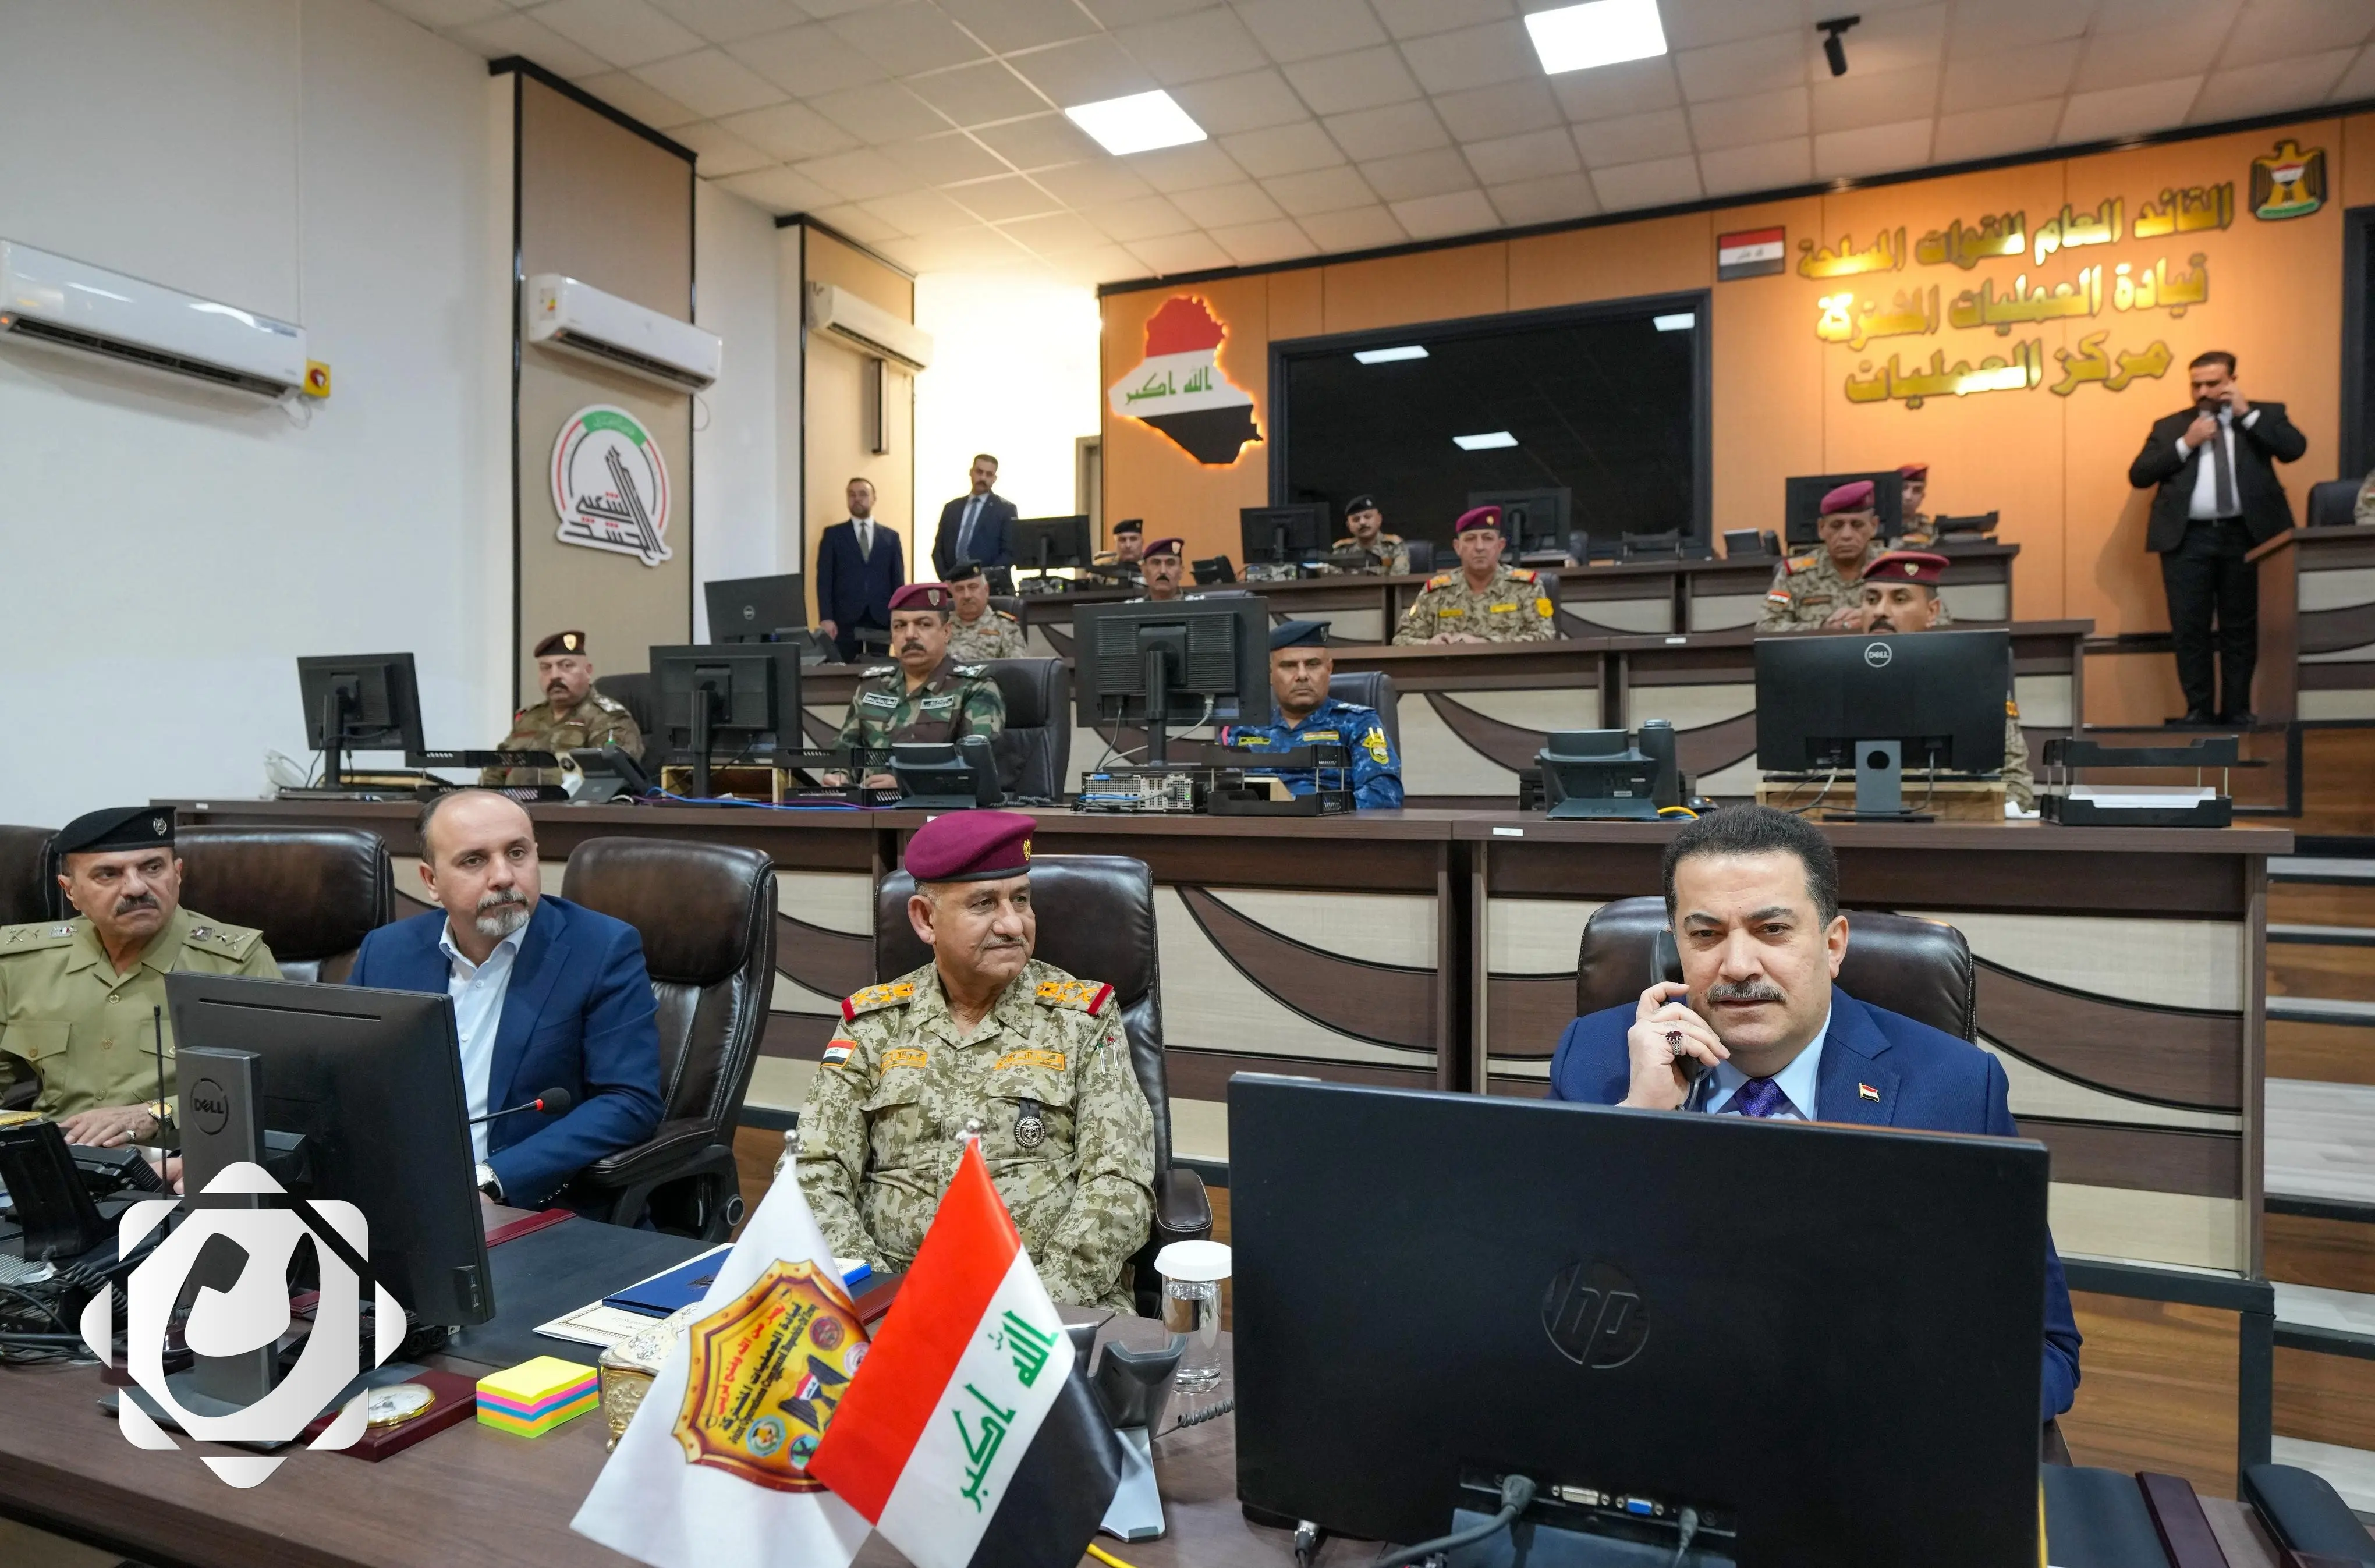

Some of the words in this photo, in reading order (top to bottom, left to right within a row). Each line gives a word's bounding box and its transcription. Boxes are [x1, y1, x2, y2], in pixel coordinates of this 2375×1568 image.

[2034, 196, 2124, 266] العام
[2133, 181, 2234, 238] القائد
[1797, 226, 1907, 281] المسلحة
[1916, 210, 2026, 270] للقوات
[1948, 263, 2103, 336] العمليات
[2114, 253, 2208, 318] قيادة
[1816, 283, 1940, 350] المشتركة
[1183, 366, 1213, 393] الله
[1845, 337, 2043, 410] العمليات
[2050, 330, 2174, 396] مركز
[1868, 651, 1890, 659] DELL
[194, 1098, 225, 1115] DELL
[752, 1322, 766, 1340] من
[767, 1305, 785, 1325] نصر
[778, 1301, 802, 1331] قيادة
[1553, 1262, 1640, 1363] hp
[738, 1337, 752, 1356] الله
[749, 1331, 784, 1385] العمليات
[988, 1310, 1059, 1389] الله
[719, 1385, 753, 1431] المشتركة
